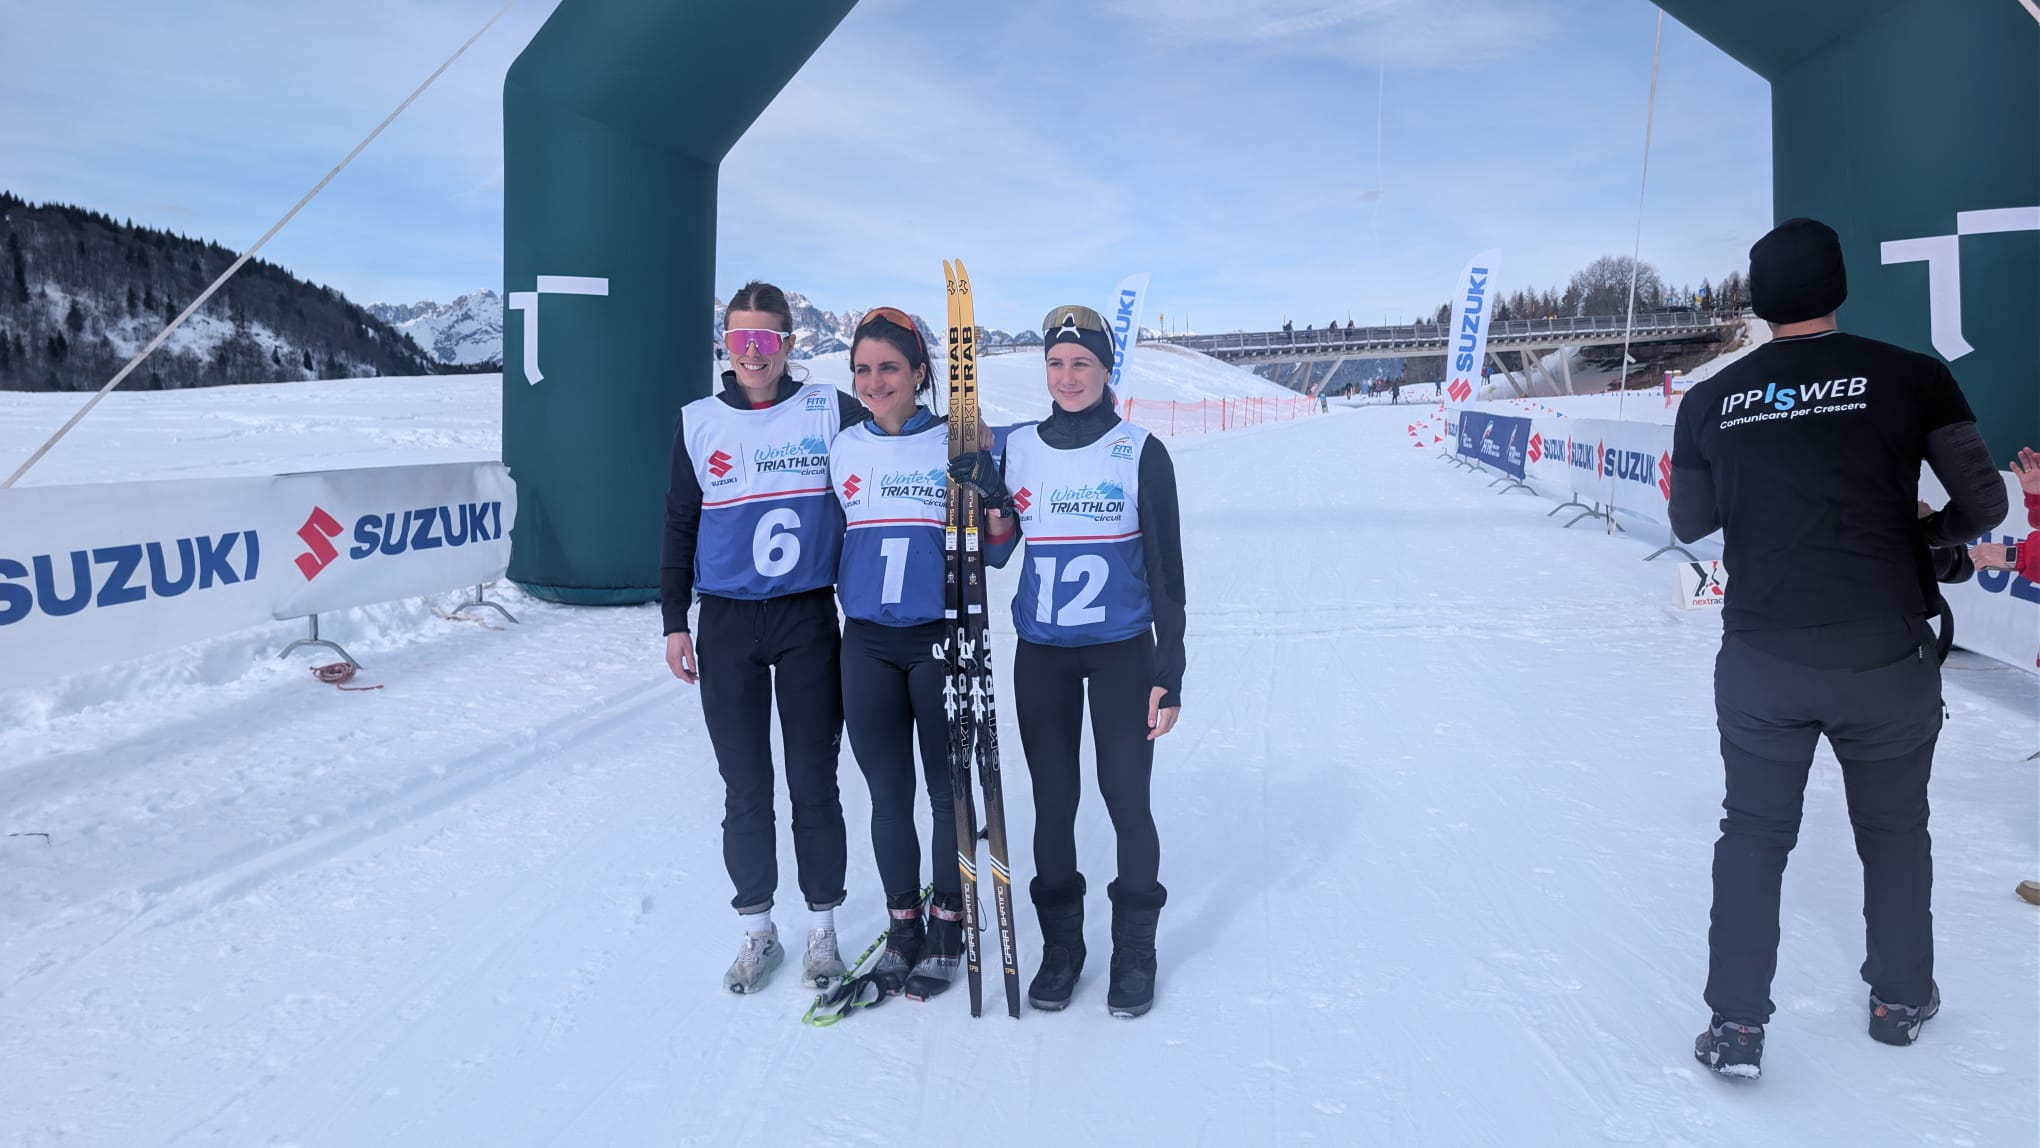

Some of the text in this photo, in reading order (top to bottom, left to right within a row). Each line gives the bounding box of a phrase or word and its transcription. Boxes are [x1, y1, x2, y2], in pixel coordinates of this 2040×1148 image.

[1456, 267, 1488, 372] SUZUKI
[1109, 289, 1136, 386] SUZUKI
[1720, 402, 1867, 429] Comunicare per Crescere
[754, 441, 803, 462] Winter
[1543, 438, 1566, 462] SUZUKI
[1571, 441, 1594, 471] SUZUKI
[755, 456, 829, 473] TRIATHLON
[801, 466, 826, 476] circuit
[711, 477, 738, 487] SUZUKI
[880, 470, 930, 486] Winter
[1050, 484, 1100, 502] Winter
[1050, 501, 1125, 513] TRIATHLON
[1094, 513, 1122, 522] circuit
[350, 502, 502, 560] SUZUKI
[752, 508, 801, 577] 6
[0, 530, 260, 626] SUZUKI
[880, 537, 910, 604] 1
[1034, 555, 1109, 627] 12
[1692, 598, 1723, 606] nextrac
